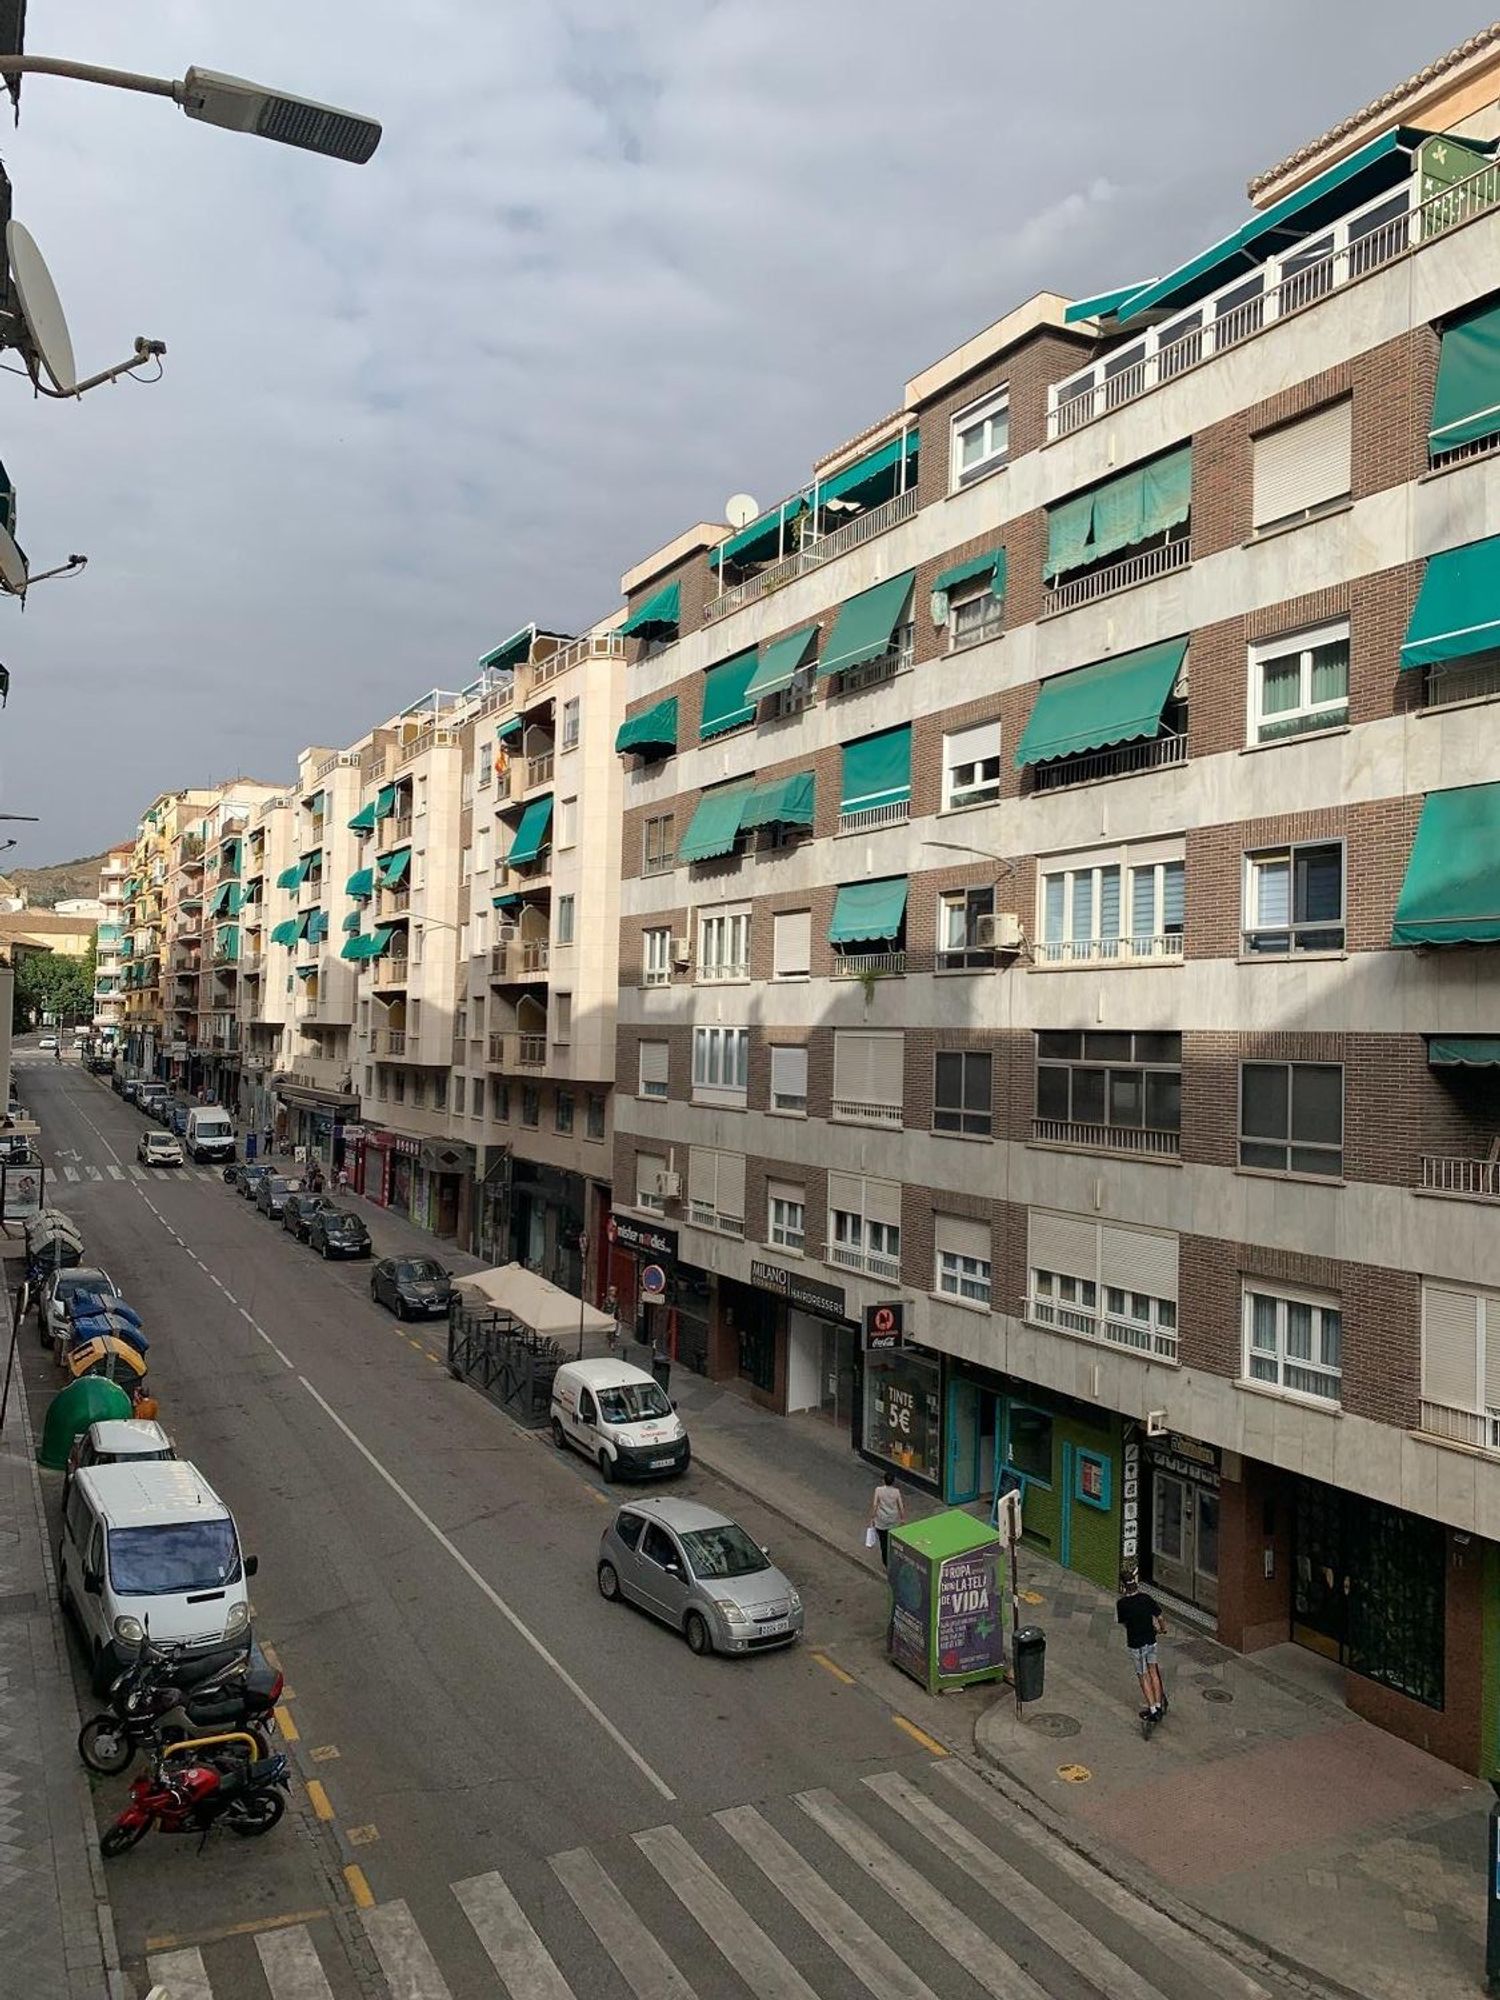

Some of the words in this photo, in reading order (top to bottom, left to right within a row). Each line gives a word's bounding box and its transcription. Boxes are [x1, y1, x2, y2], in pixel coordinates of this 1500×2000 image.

[752, 1262, 787, 1286] MILANO
[790, 1286, 844, 1316] HAIRDRESSERS
[888, 1385, 913, 1409] TINTE
[889, 1403, 910, 1434] 5€
[949, 1564, 971, 1579] ROPA
[941, 1594, 951, 1606] DE
[951, 1588, 989, 1615] VIDA
